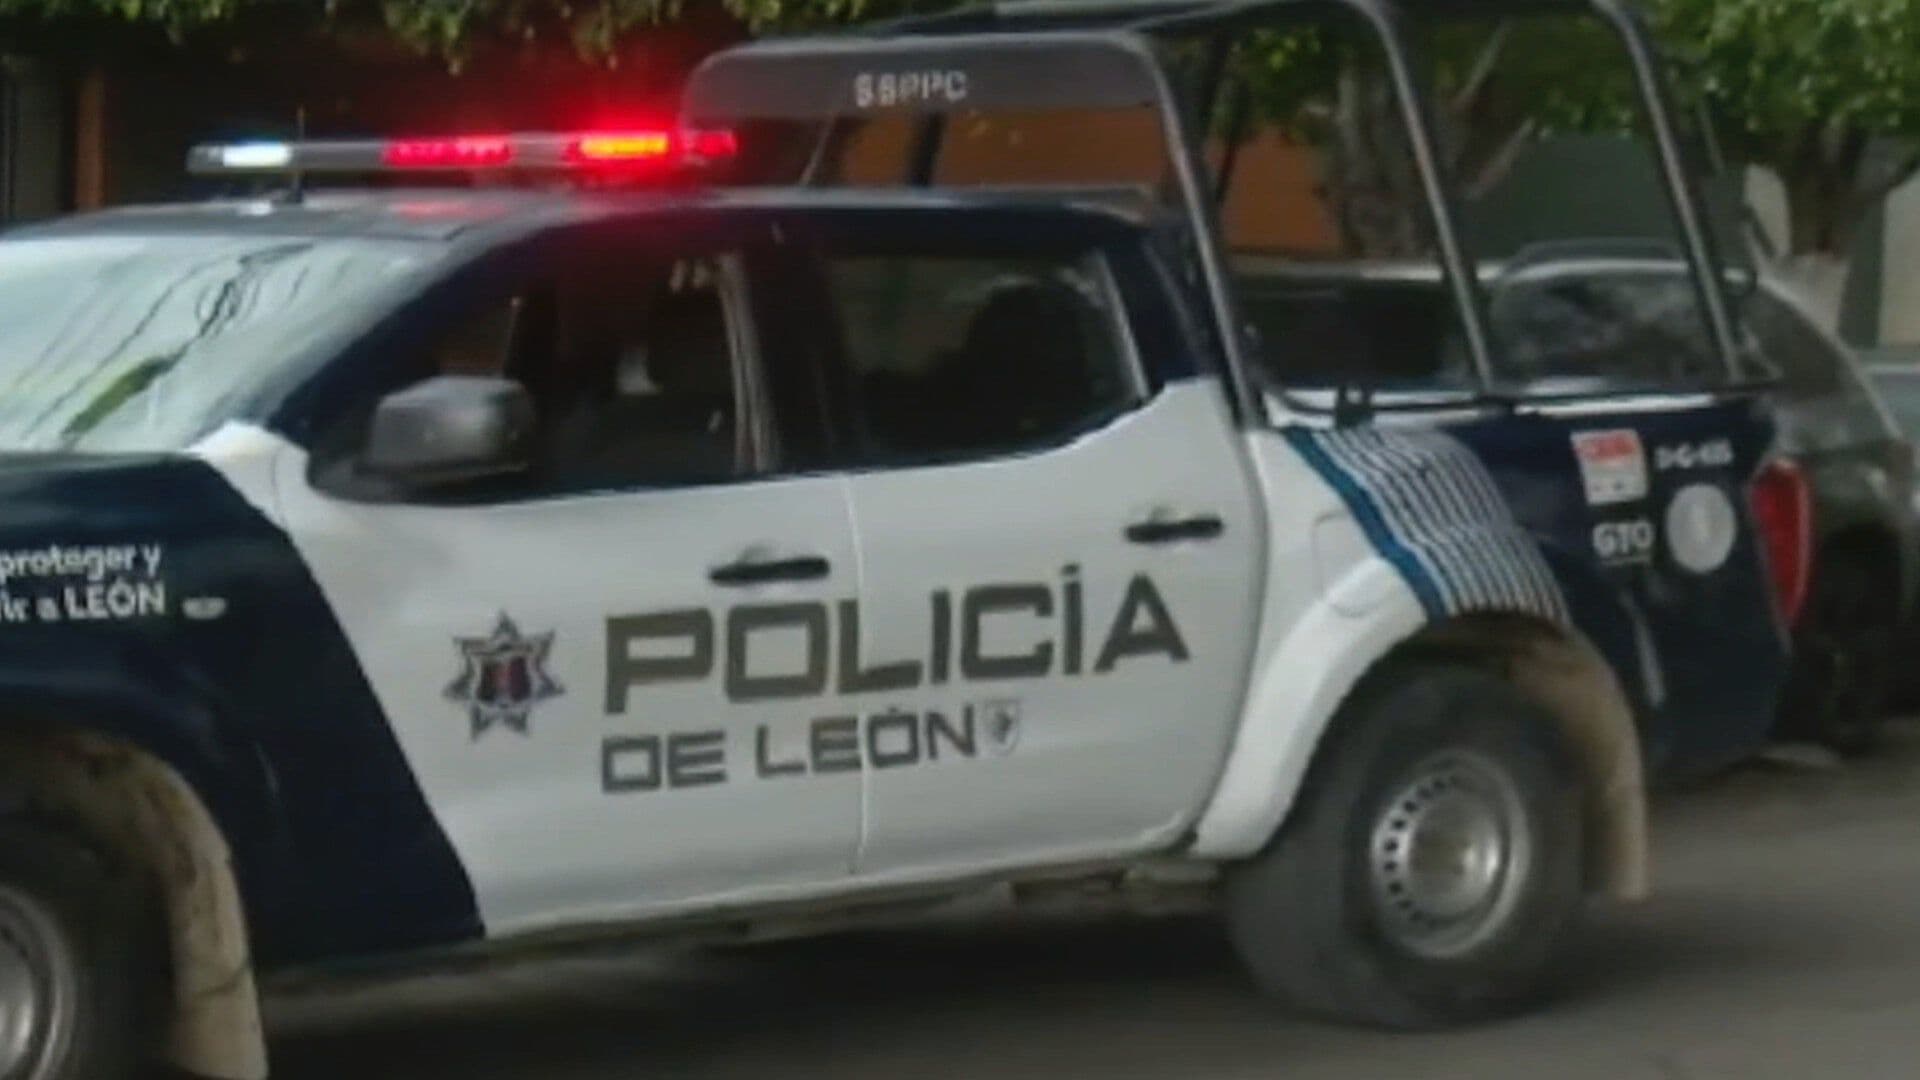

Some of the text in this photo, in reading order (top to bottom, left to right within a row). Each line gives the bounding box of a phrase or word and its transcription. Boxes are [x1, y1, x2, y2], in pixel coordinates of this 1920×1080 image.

[1593, 518, 1655, 557] GTO
[63, 576, 166, 620] LEÓN
[604, 563, 1190, 714] POLICÍA
[602, 706, 975, 794] DE LEÓN
